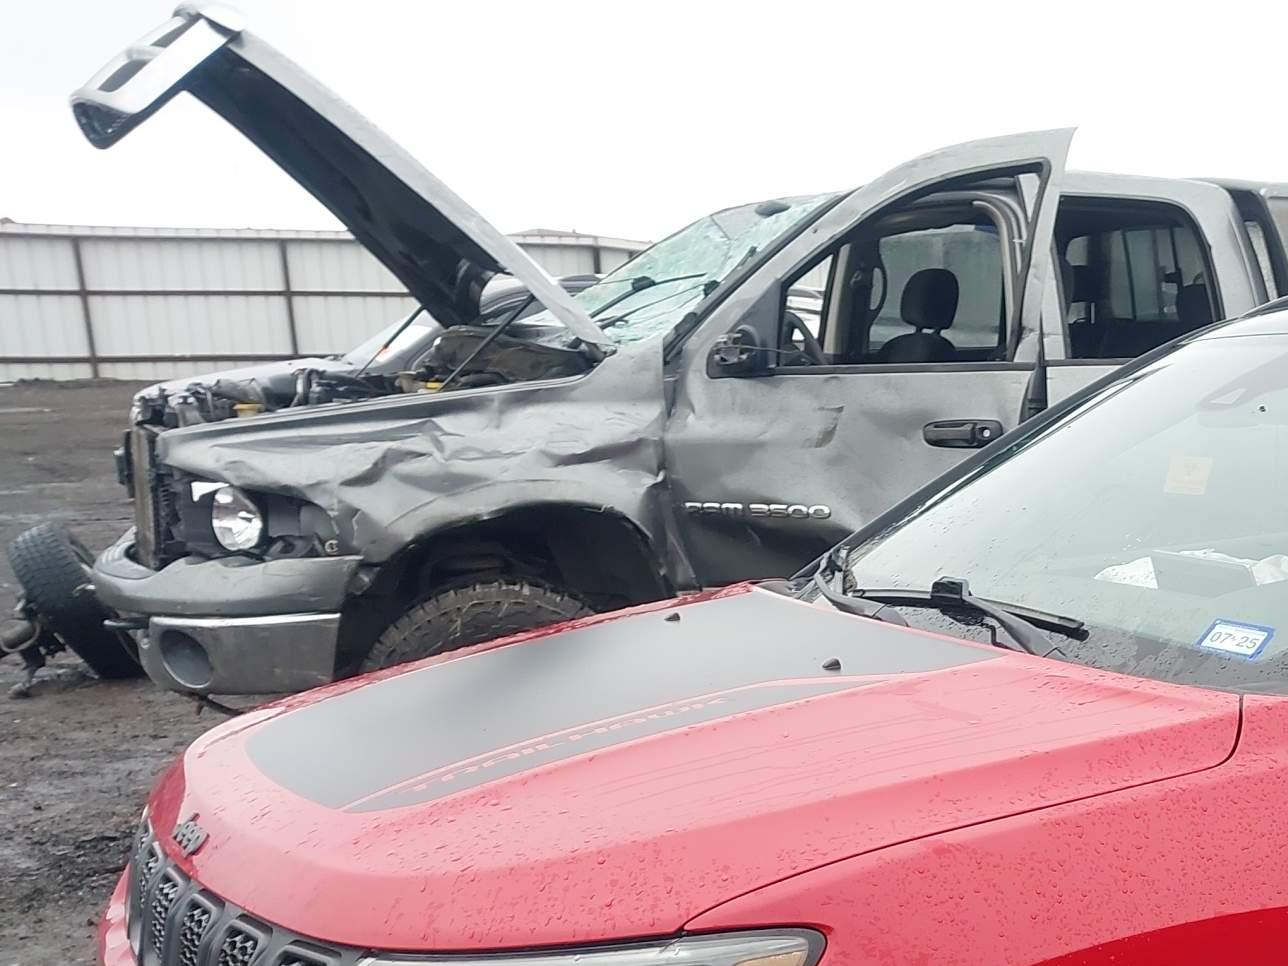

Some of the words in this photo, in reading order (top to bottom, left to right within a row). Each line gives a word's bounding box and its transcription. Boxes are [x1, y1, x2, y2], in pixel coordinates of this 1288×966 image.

[748, 503, 832, 519] 3500
[1210, 631, 1233, 643] 07
[1235, 636, 1260, 649] 25
